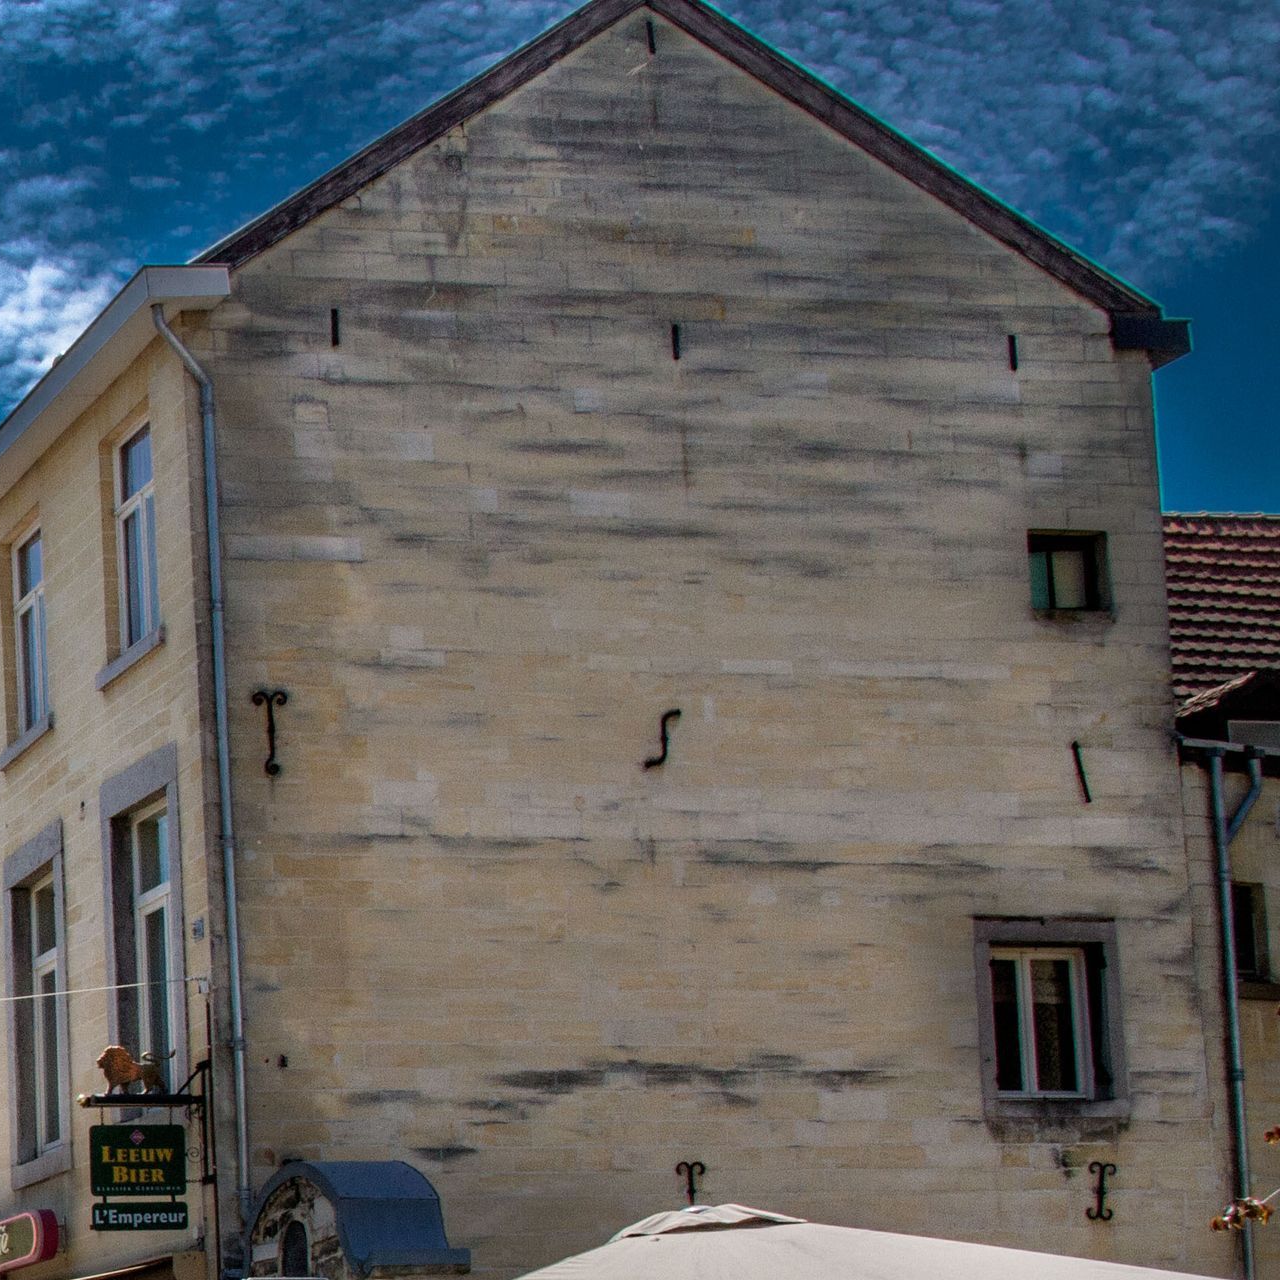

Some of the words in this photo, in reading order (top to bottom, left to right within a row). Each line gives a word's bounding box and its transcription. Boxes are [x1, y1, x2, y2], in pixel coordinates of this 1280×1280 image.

[101, 1145, 174, 1163] LEEUW
[112, 1166, 165, 1183] BIER
[95, 1209, 185, 1227] L'Empereur
